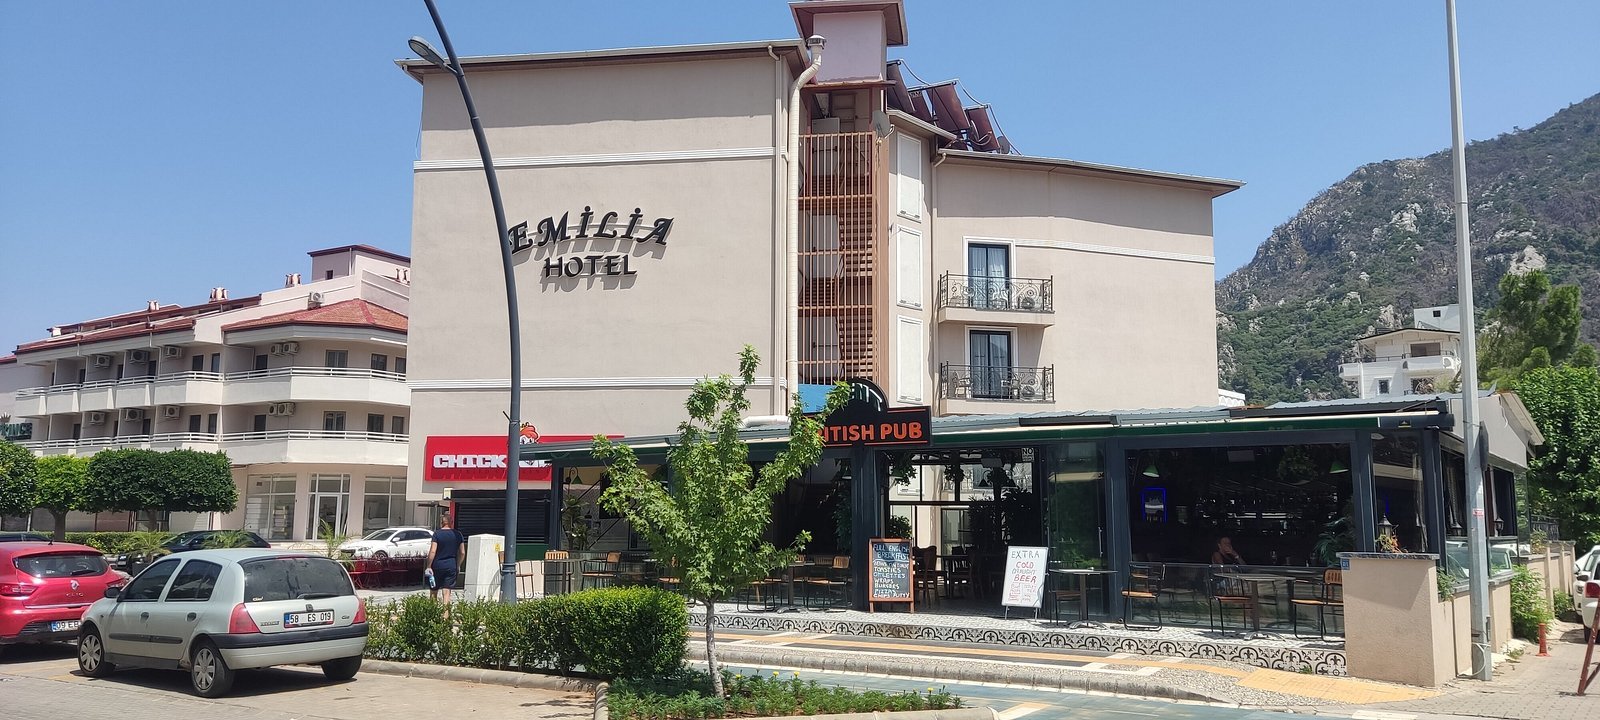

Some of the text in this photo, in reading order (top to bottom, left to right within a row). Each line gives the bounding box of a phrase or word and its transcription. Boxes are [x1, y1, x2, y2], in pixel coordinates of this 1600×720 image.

[543, 254, 638, 278] HOTEL
[817, 421, 922, 442] ITISH PUB
[1022, 447, 1034, 455] NO
[1011, 550, 1040, 559] EXTRA
[1015, 561, 1035, 569] COLD
[1013, 574, 1037, 583] BEER
[290, 615, 299, 624] 58
[307, 613, 316, 623] ES
[320, 612, 331, 621] 019
